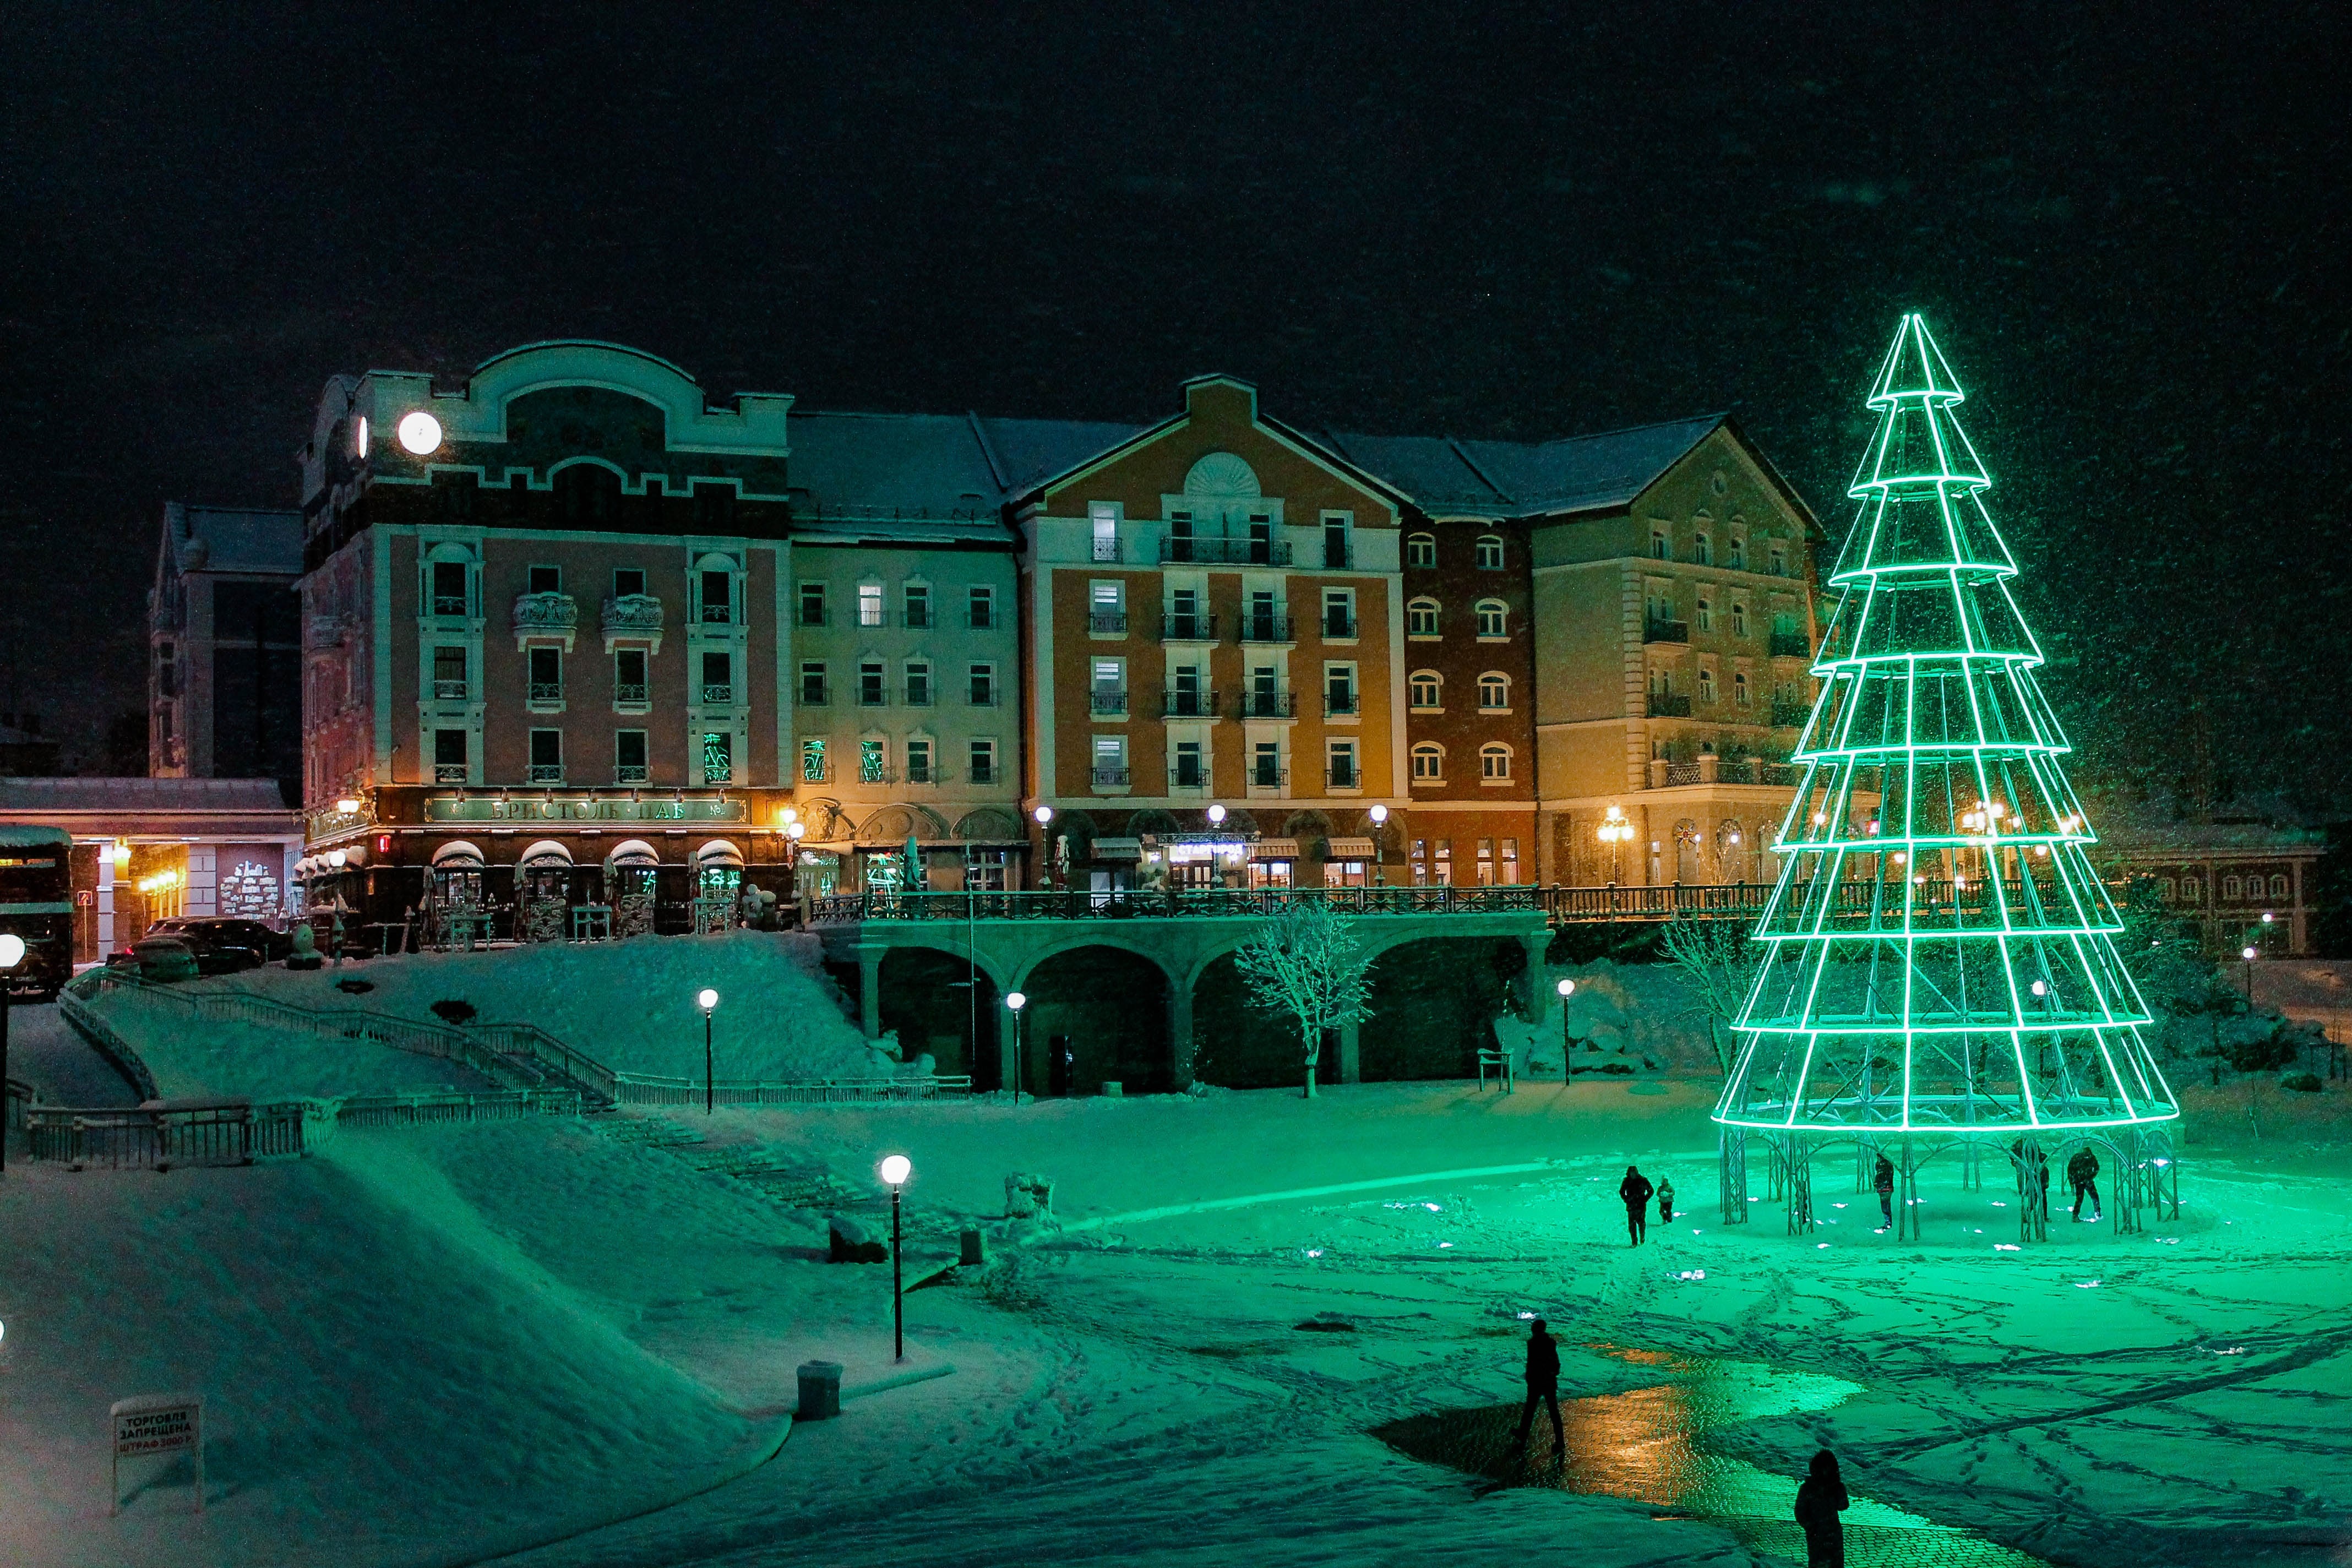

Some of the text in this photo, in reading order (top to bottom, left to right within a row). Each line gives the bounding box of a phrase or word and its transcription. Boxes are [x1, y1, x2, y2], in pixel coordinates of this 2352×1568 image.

[491, 802, 617, 819] БРИСТОЛЬ
[639, 802, 685, 819] ПАБ
[126, 1412, 186, 1427] ТОРГОВЛЯ
[120, 1423, 192, 1440] ЗАПРЕЩЕНА
[119, 1440, 159, 1452] ШТРАФ
